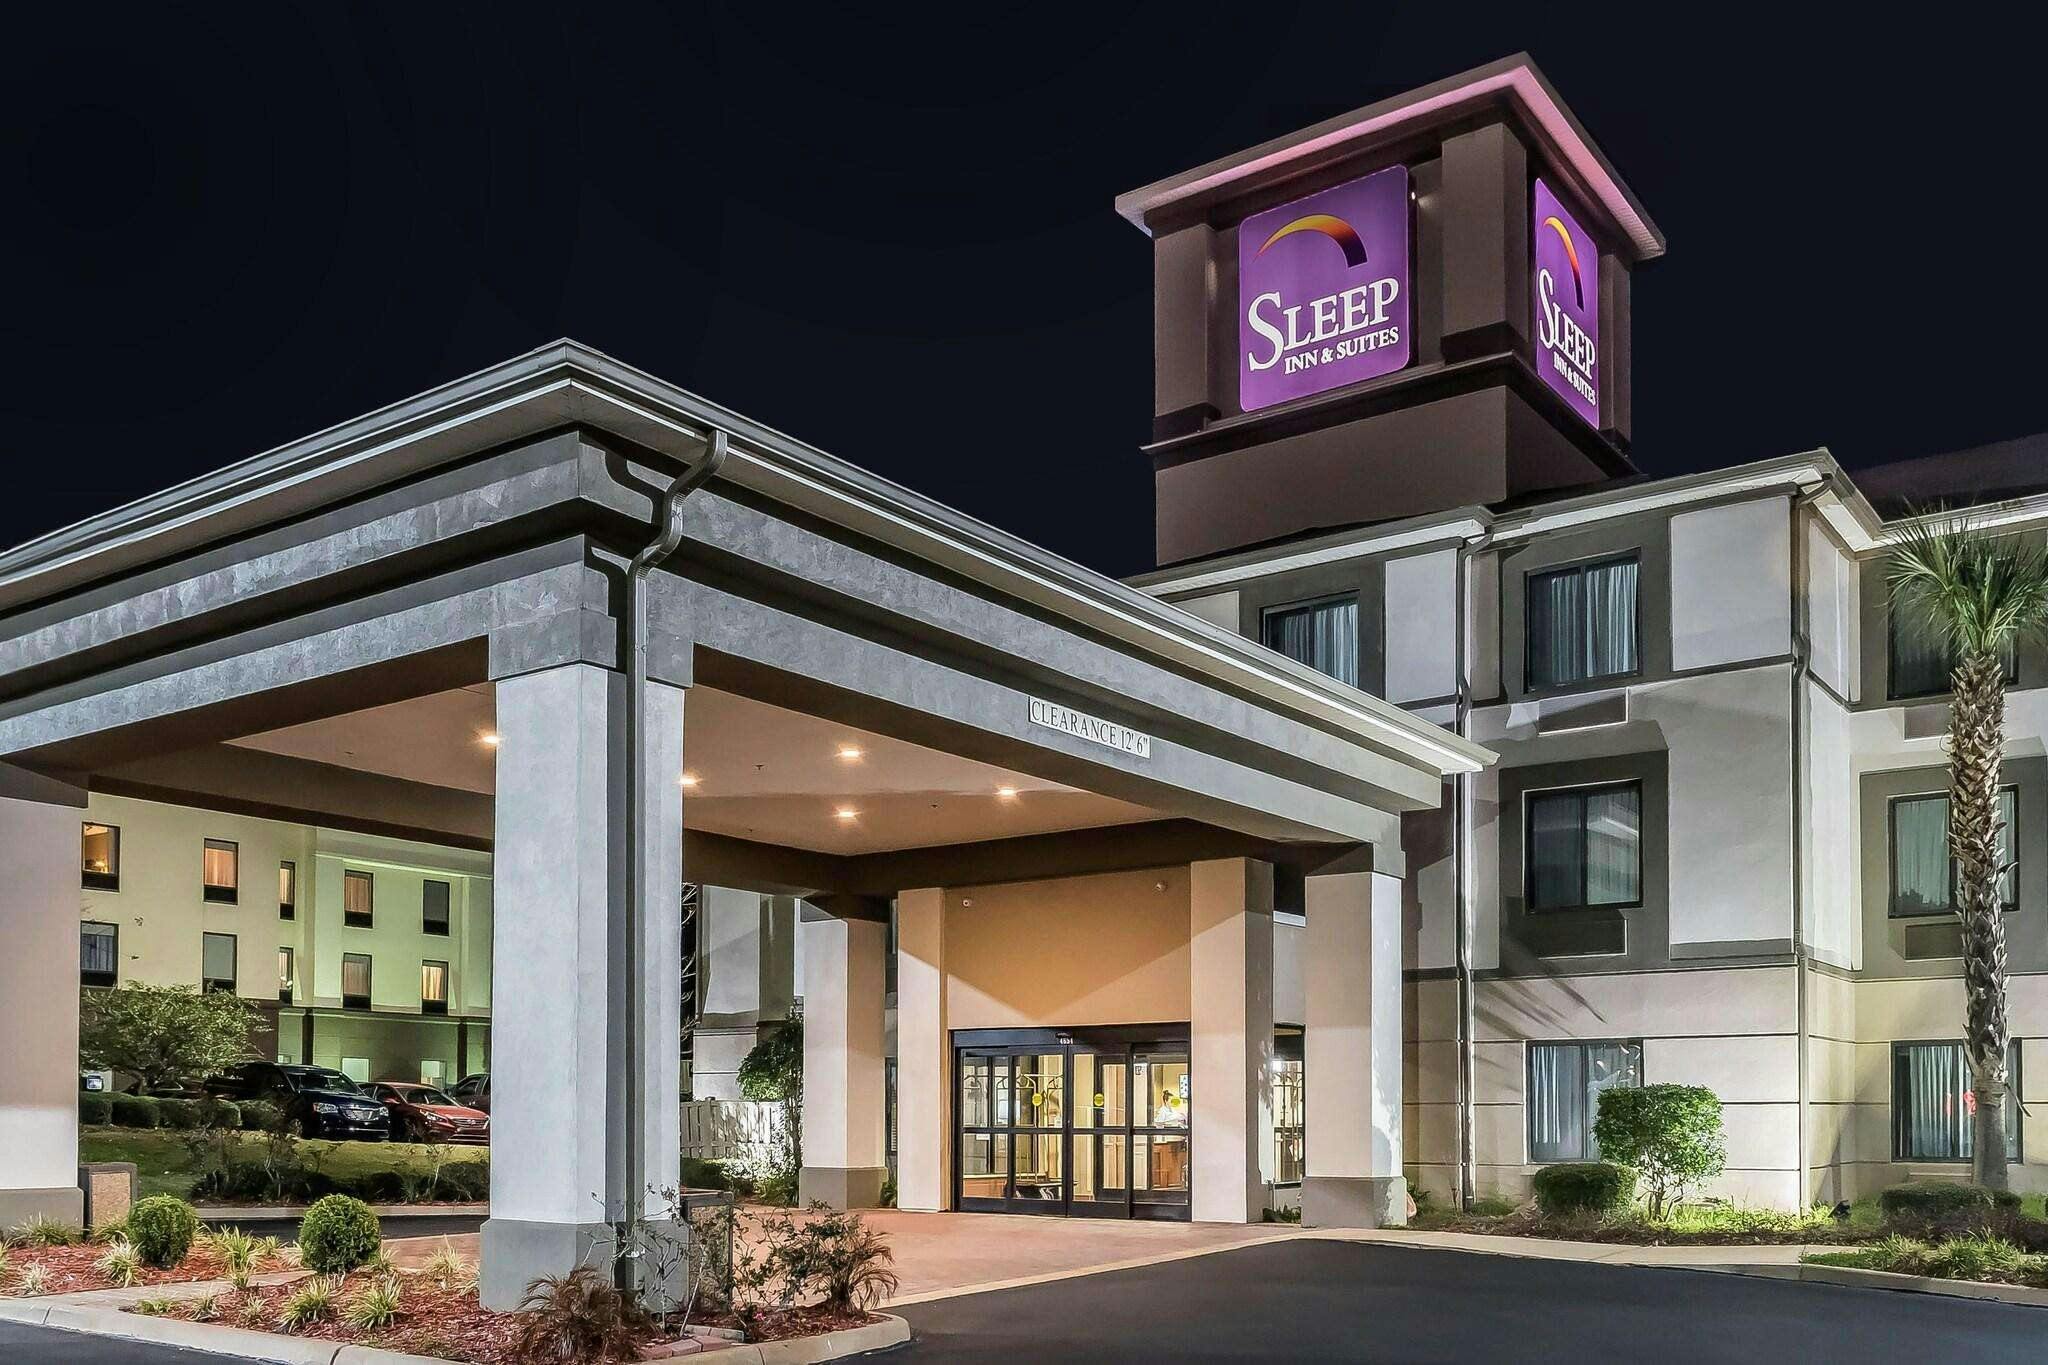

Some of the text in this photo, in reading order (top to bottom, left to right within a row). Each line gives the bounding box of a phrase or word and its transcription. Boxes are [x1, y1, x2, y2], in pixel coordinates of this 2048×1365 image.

[1248, 278, 1400, 372] SLEEP
[1284, 326, 1400, 375] INN & SUITES
[1539, 268, 1596, 380] SLEEP
[1553, 351, 1568, 378] INN
[1573, 371, 1596, 406] SUITES
[1031, 700, 1118, 746] CLEARANCE
